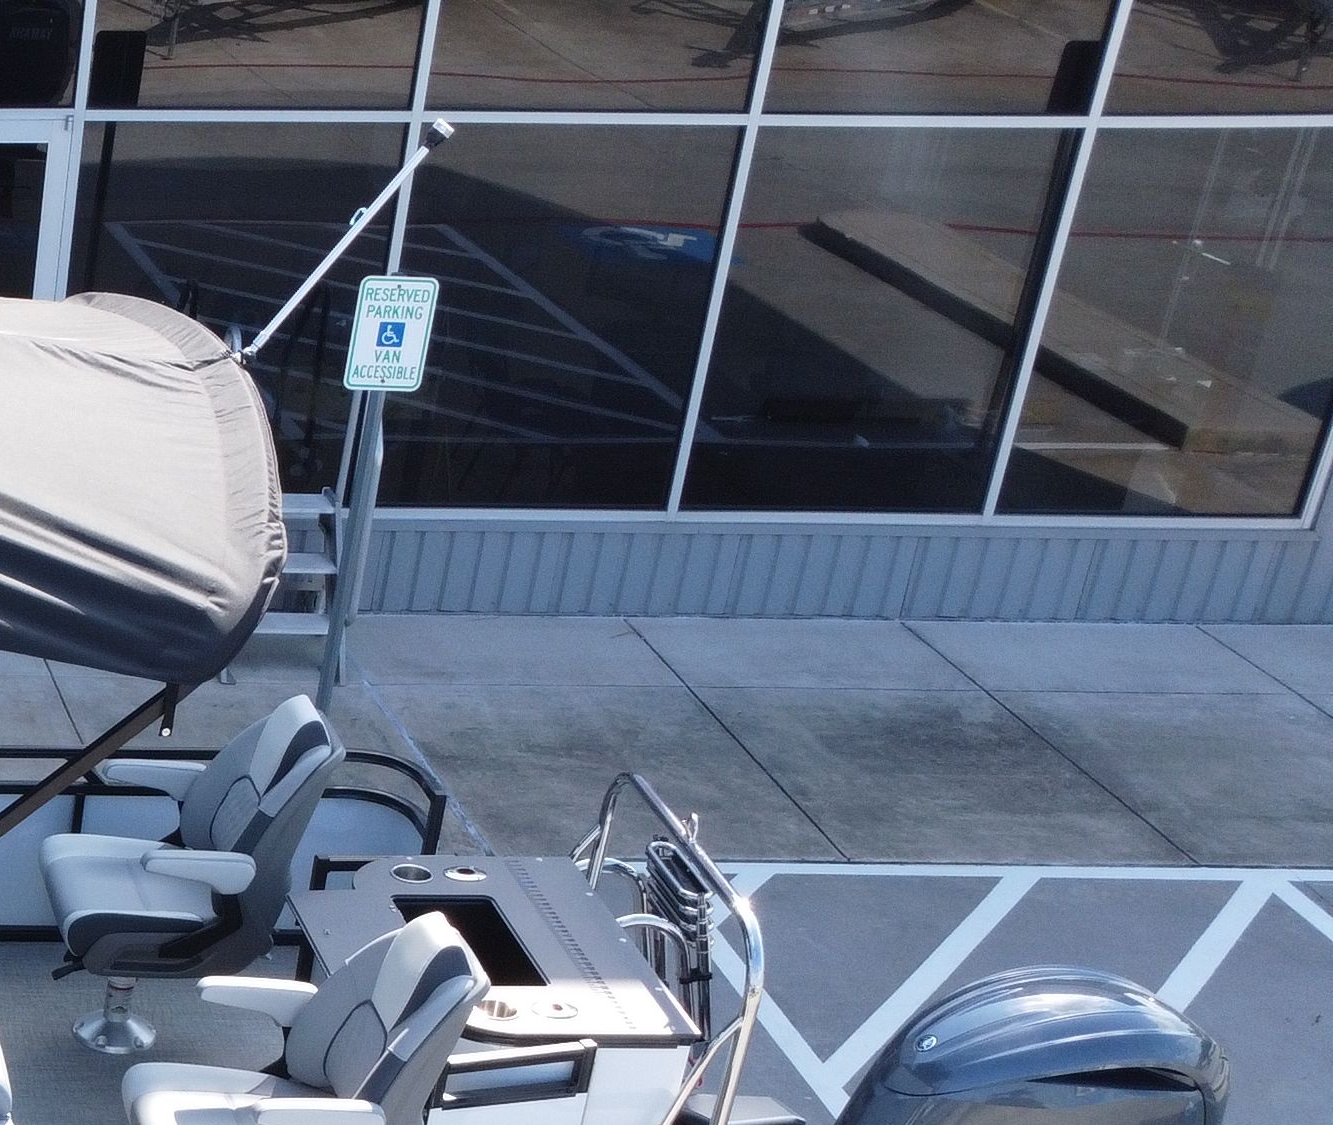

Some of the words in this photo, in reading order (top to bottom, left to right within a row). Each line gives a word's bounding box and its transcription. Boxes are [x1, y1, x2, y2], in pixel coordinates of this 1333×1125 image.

[365, 287, 431, 303] RESERVED
[366, 304, 424, 320] PARKING
[374, 350, 401, 363] VAN
[352, 365, 417, 380] ACCESSIBLE
